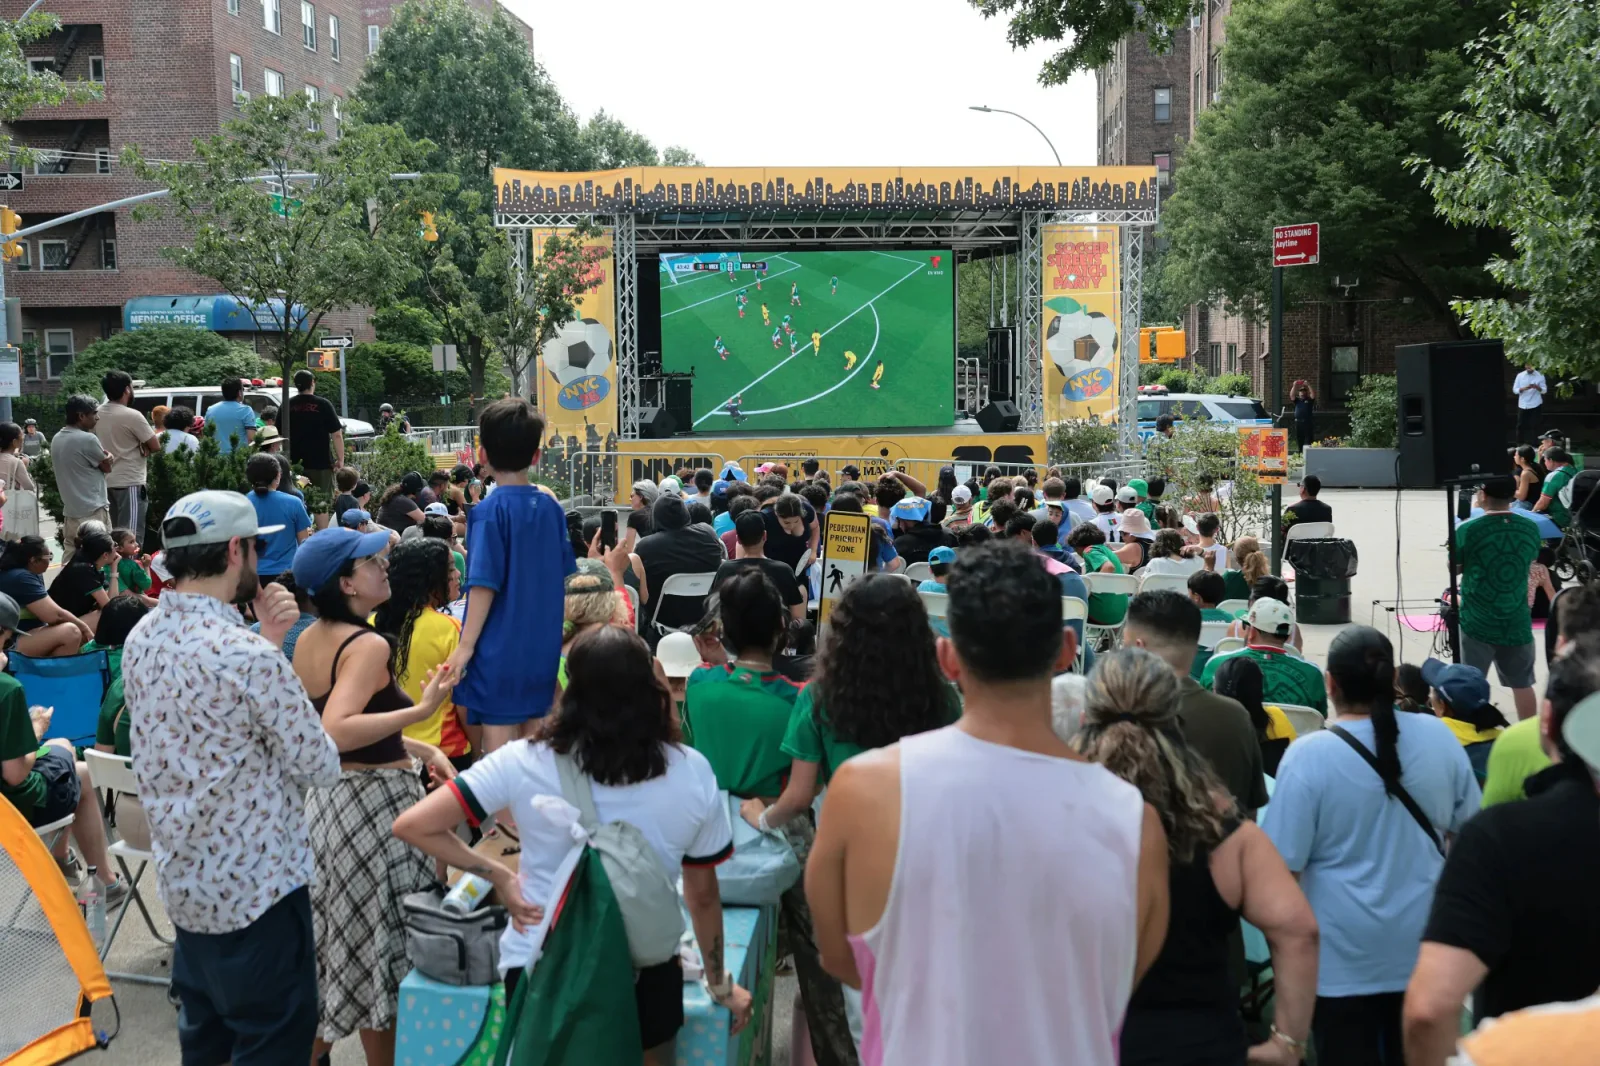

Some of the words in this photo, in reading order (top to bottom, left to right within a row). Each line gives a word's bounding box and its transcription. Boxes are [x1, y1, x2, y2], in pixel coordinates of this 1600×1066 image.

[1275, 231, 1284, 239] NO
[1284, 228, 1312, 238] STANDING
[1055, 242, 1109, 254] SOCCER
[1276, 240, 1298, 249] Anytime
[1047, 254, 1103, 266] STREETS
[1056, 265, 1107, 278] WATCH
[1053, 276, 1102, 289] PARTY
[130, 315, 171, 323] MEDICAL
[173, 314, 207, 323] OFFICE
[1070, 369, 1103, 391] NYC
[565, 376, 599, 400] NYC
[182, 501, 216, 530] YORK
[829, 523, 866, 534] PEDESTRIAN
[830, 534, 863, 543] PRIORITY
[836, 545, 855, 553] ZONE
